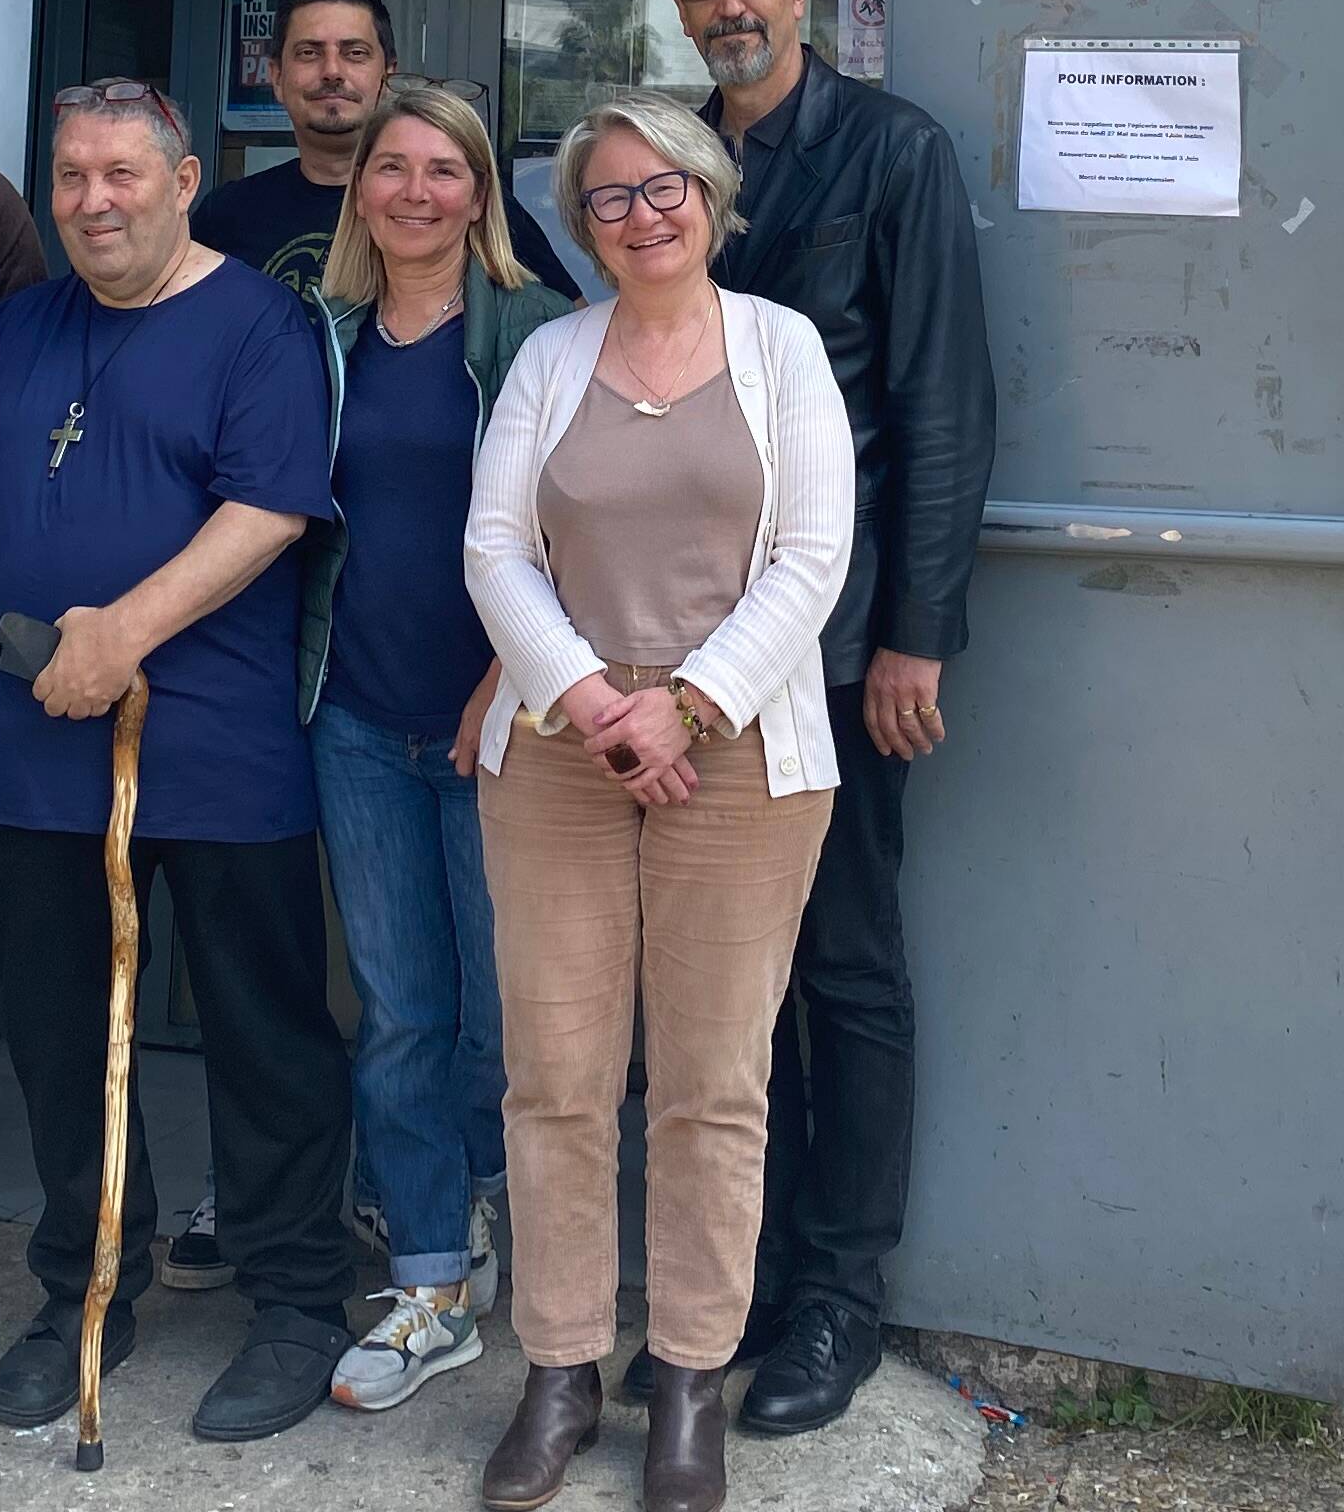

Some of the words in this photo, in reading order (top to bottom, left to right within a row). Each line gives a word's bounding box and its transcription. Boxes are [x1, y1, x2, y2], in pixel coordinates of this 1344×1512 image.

[243, 0, 261, 12] Tu
[242, 41, 261, 55] Tu
[242, 56, 270, 84] PA
[1058, 73, 1097, 85] POUR
[1101, 74, 1197, 86] INFORMATION
